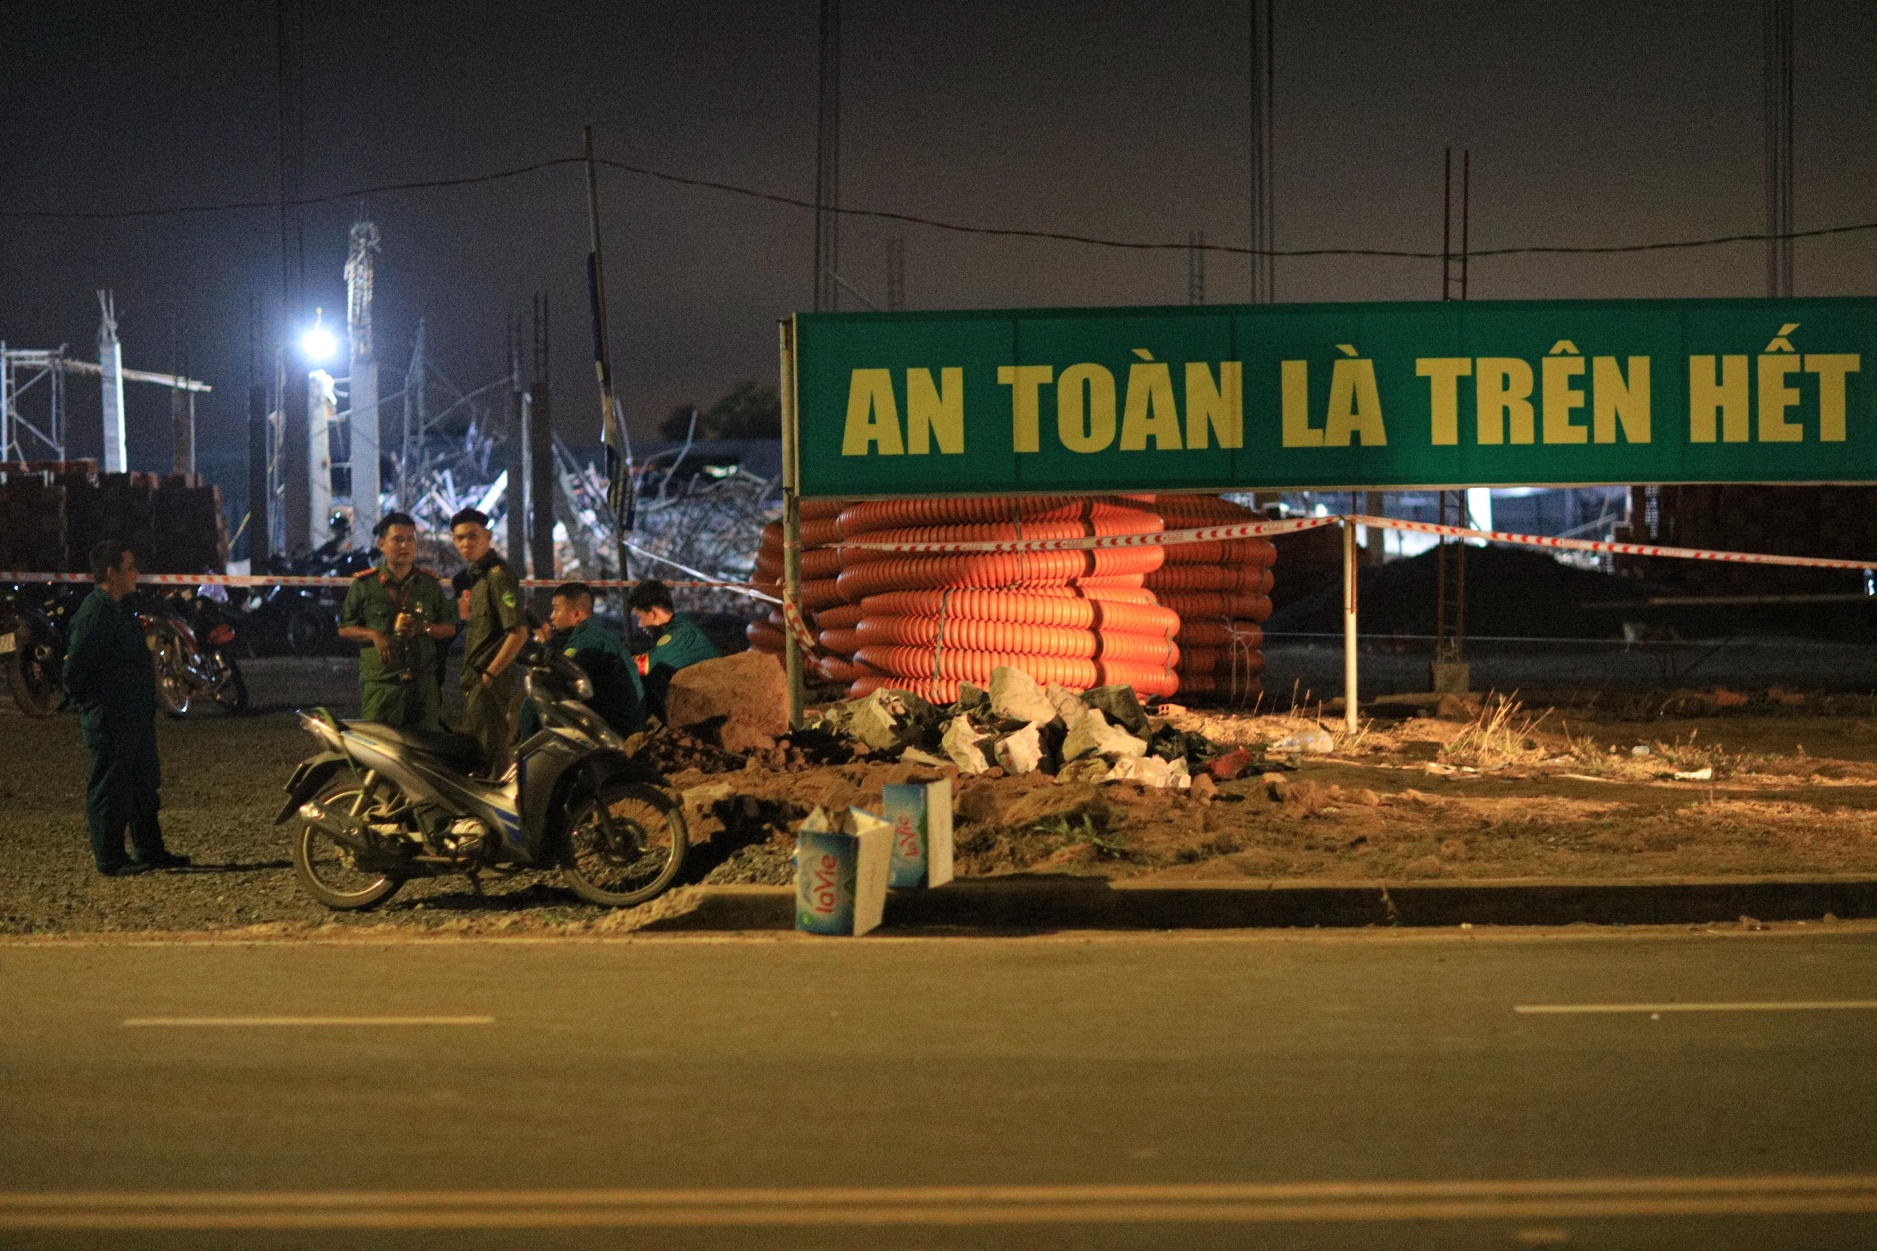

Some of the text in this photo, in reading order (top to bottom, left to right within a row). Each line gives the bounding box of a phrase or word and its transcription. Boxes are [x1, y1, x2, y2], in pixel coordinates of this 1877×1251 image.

[842, 323, 1860, 455] AN TOÀN LÀ TRÊN HẾT
